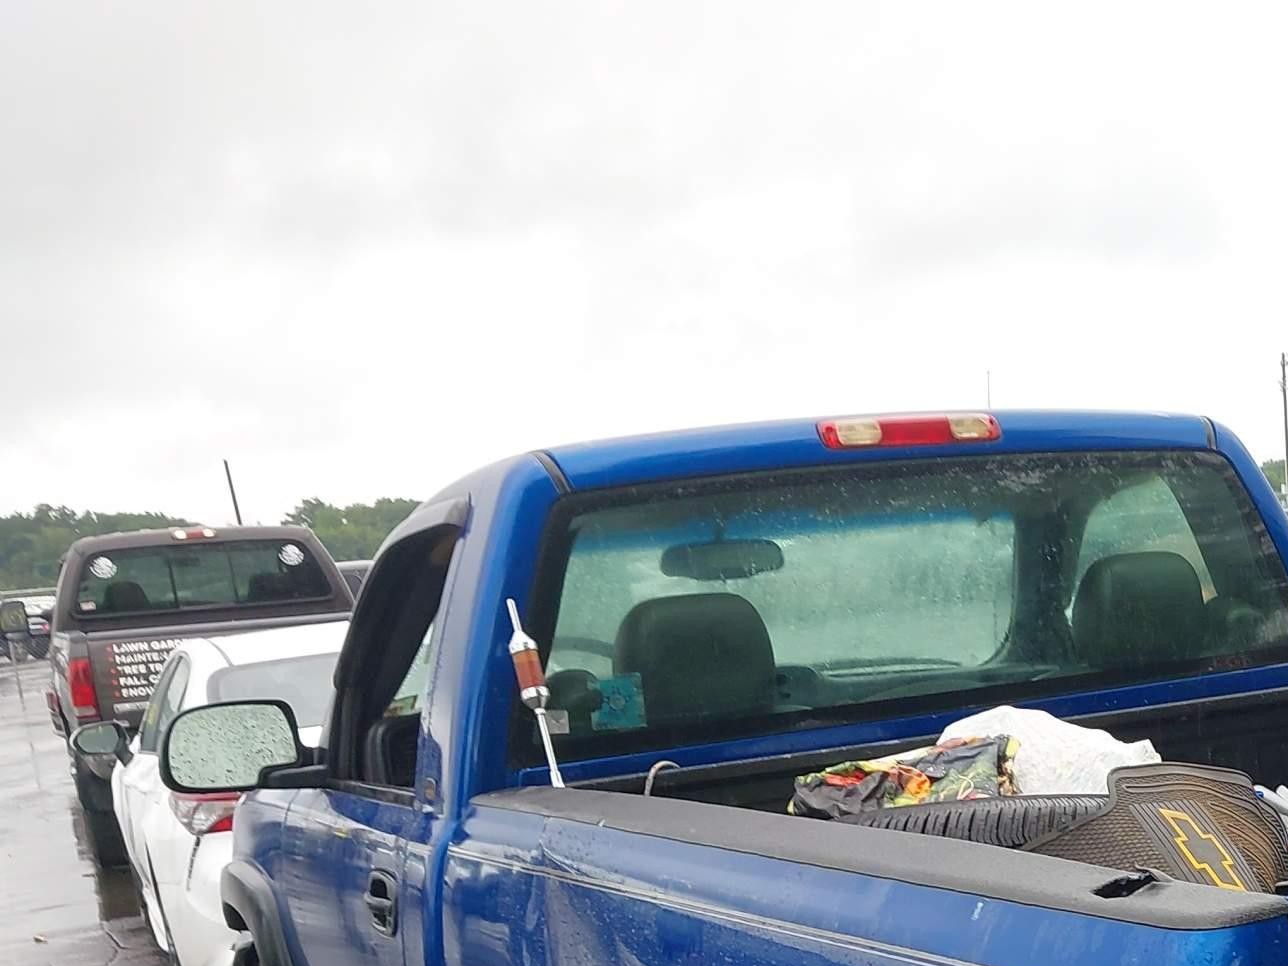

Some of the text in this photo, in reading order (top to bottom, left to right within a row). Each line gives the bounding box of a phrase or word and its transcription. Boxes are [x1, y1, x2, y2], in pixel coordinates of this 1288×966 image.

[112, 641, 149, 654] LAWN
[116, 663, 147, 675] TREE
[118, 675, 148, 687] FALL
